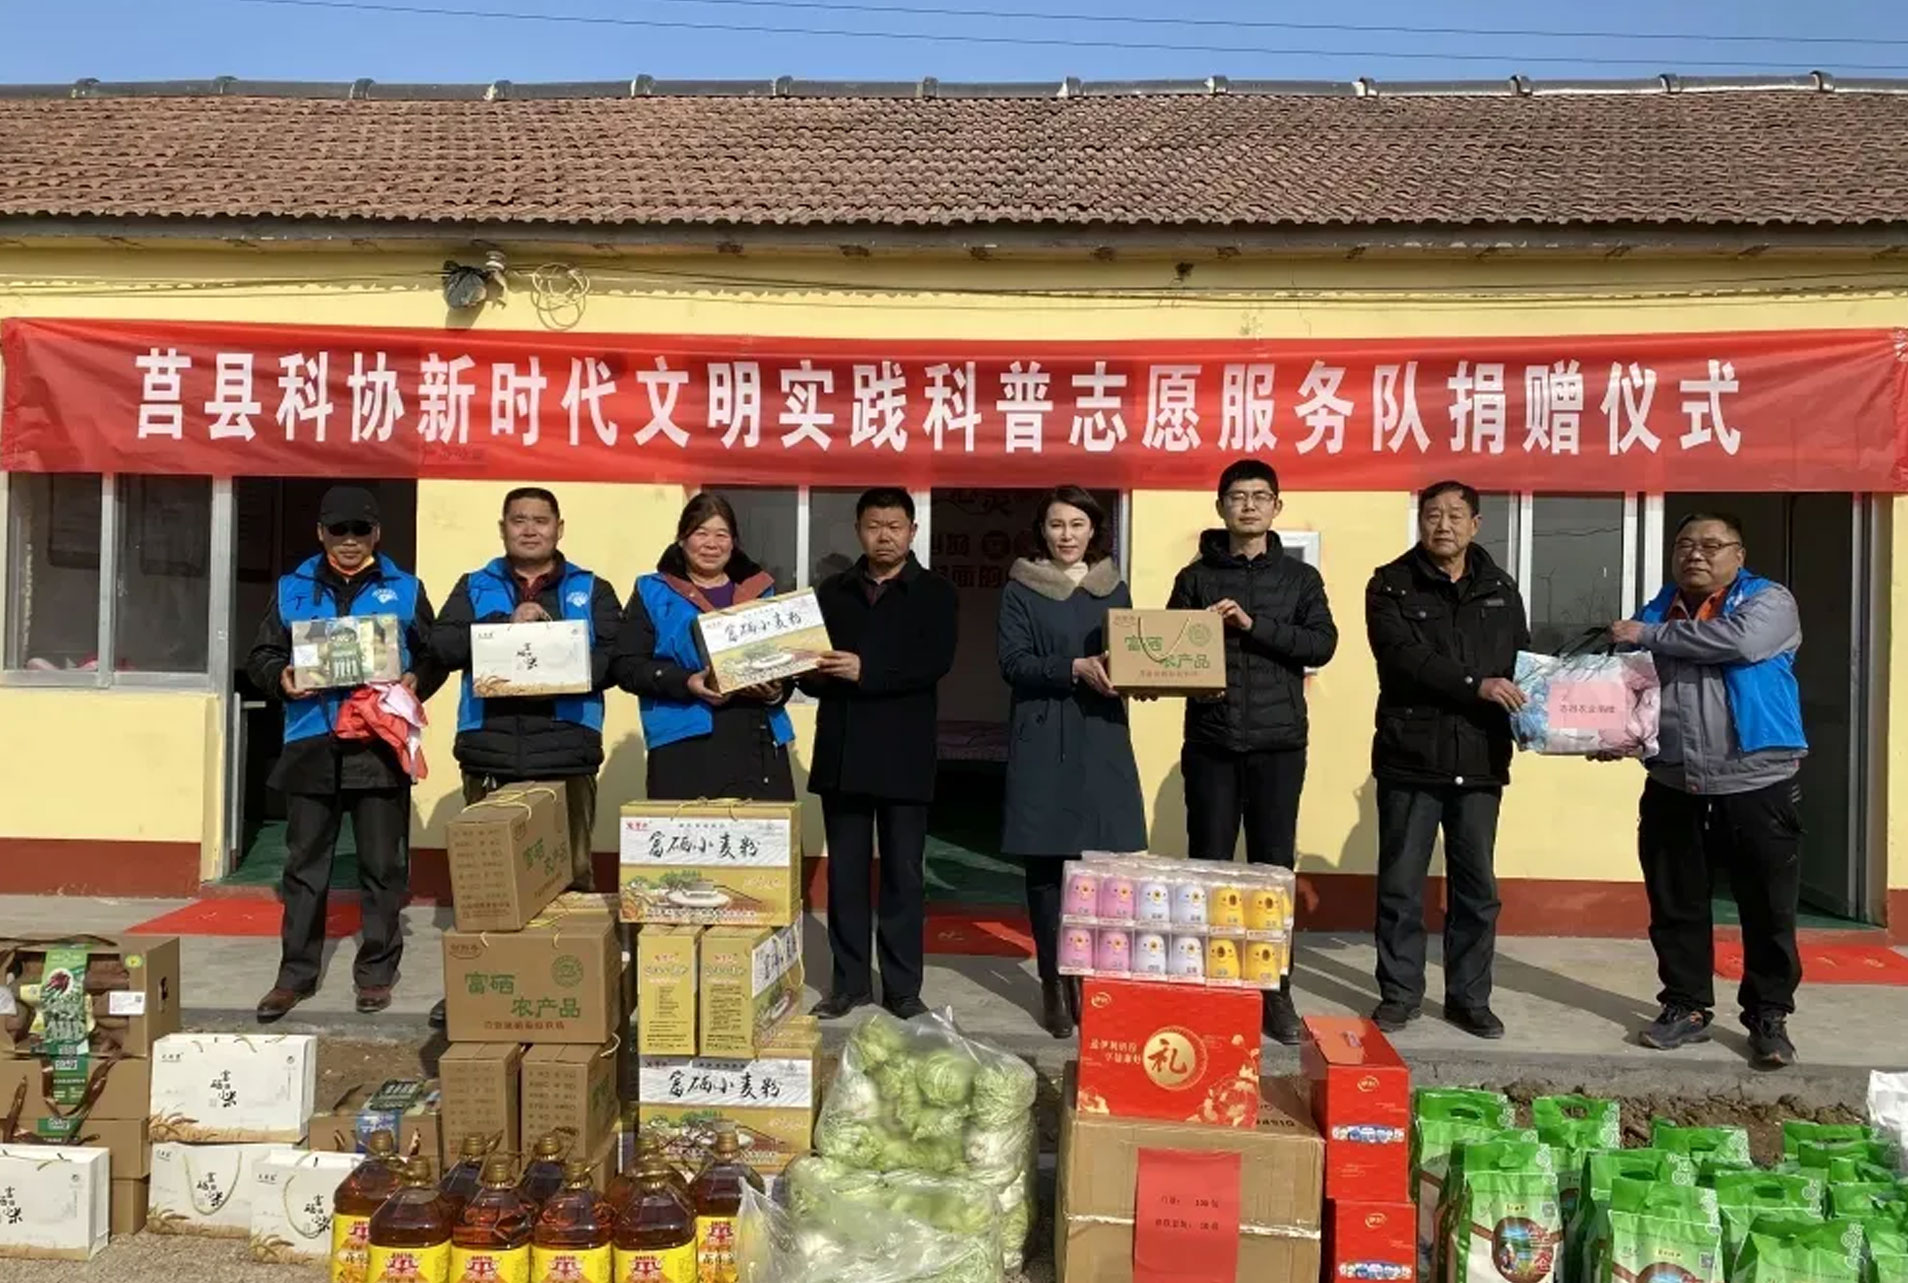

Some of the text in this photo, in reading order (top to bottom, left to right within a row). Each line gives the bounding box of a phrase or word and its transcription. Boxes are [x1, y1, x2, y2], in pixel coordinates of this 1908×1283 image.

[136, 348, 1742, 455] 莒县科协新时代文明实践科普志愿服务队捐赠仪式
[464, 971, 516, 995] 富硒
[511, 996, 581, 1018] 农产品
[1147, 1038, 1188, 1074] 礼
